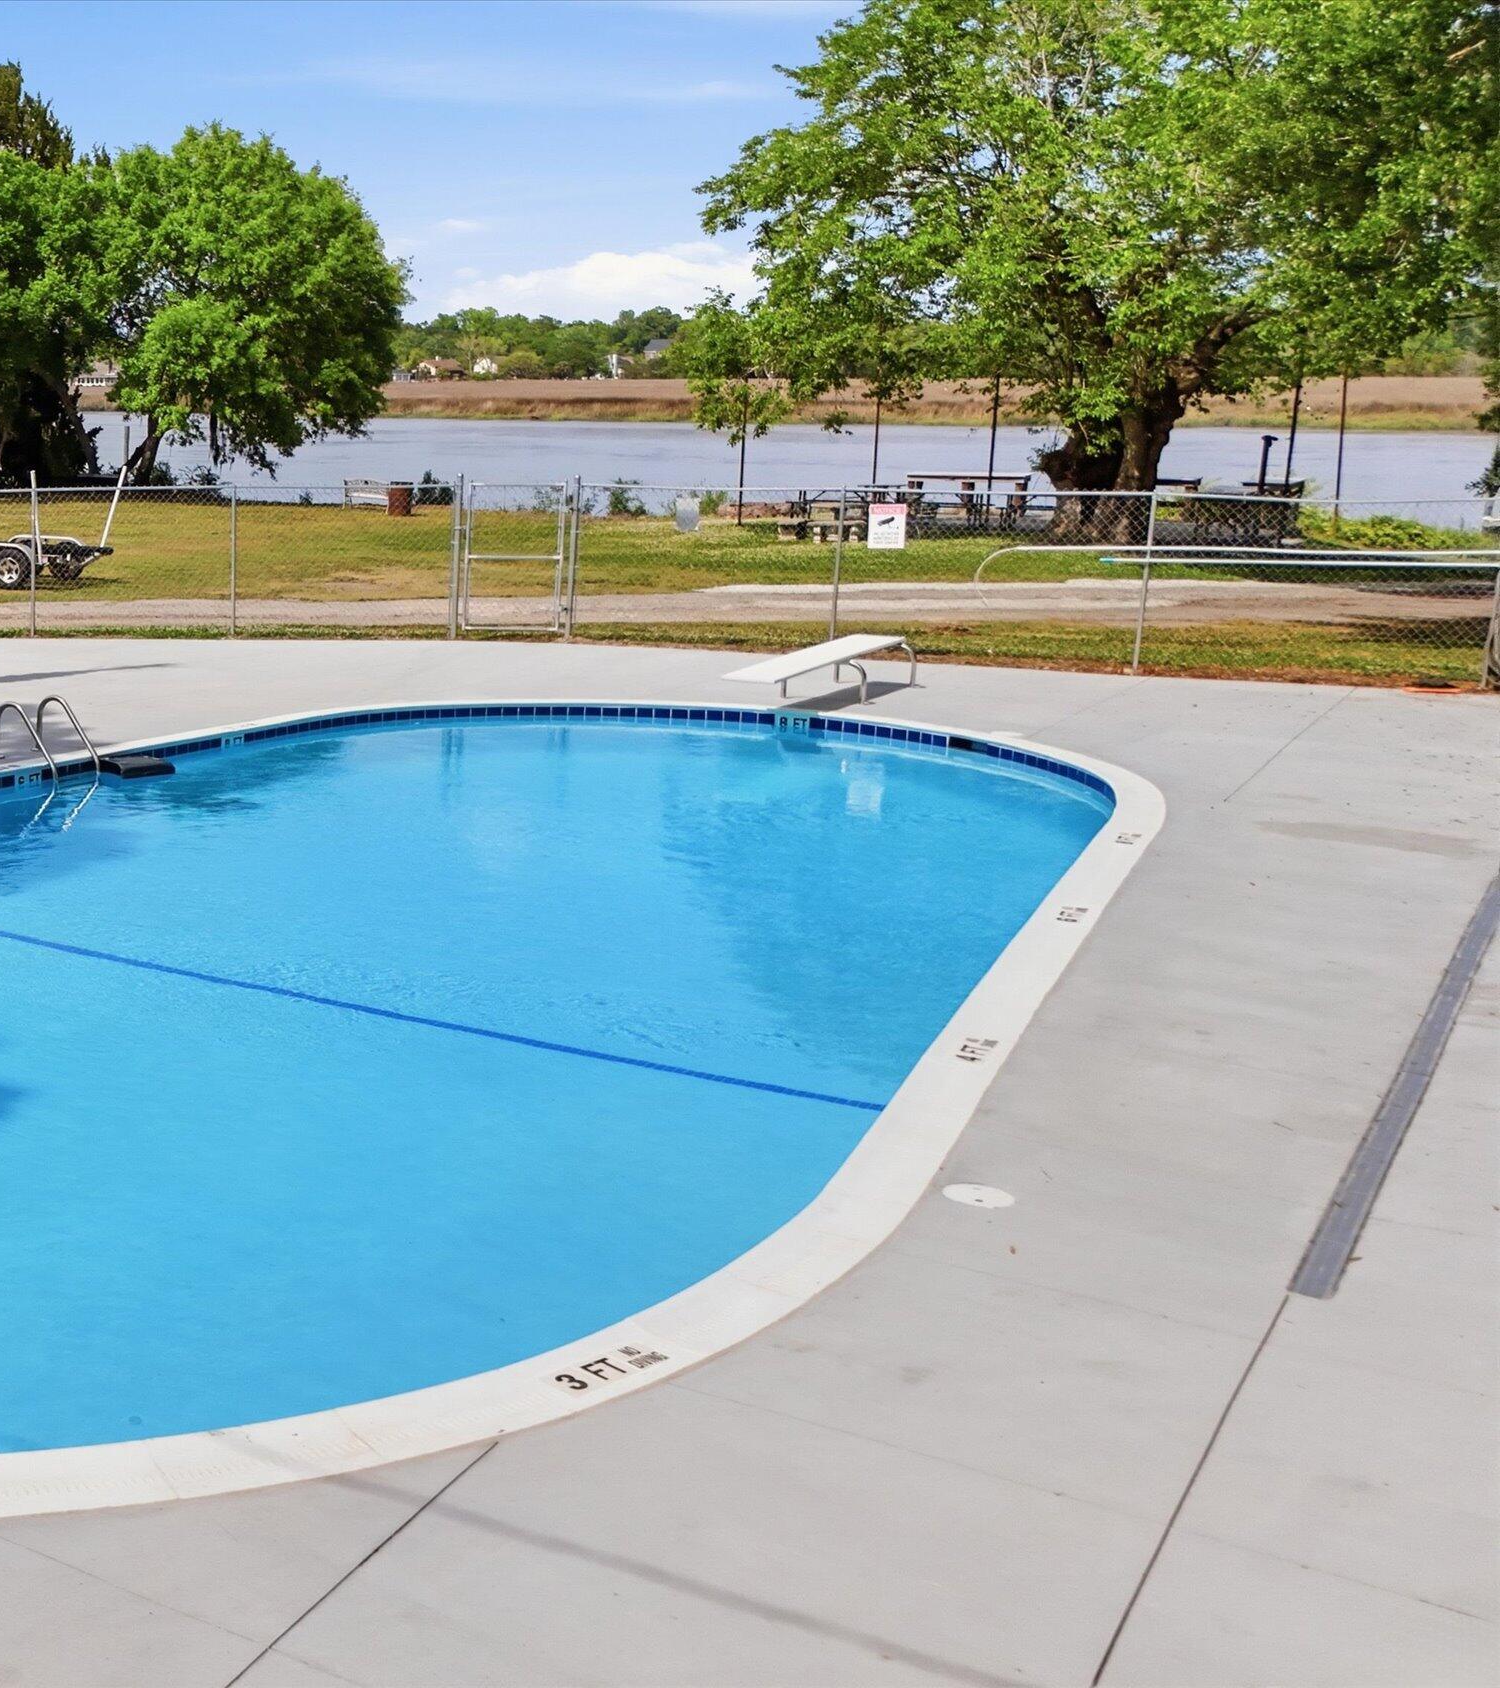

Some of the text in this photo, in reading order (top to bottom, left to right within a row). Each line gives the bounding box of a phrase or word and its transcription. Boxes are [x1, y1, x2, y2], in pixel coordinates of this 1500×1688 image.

[793, 717, 807, 729] FT
[627, 1351, 669, 1369] DIVING
[555, 1357, 627, 1390] 3 FT
